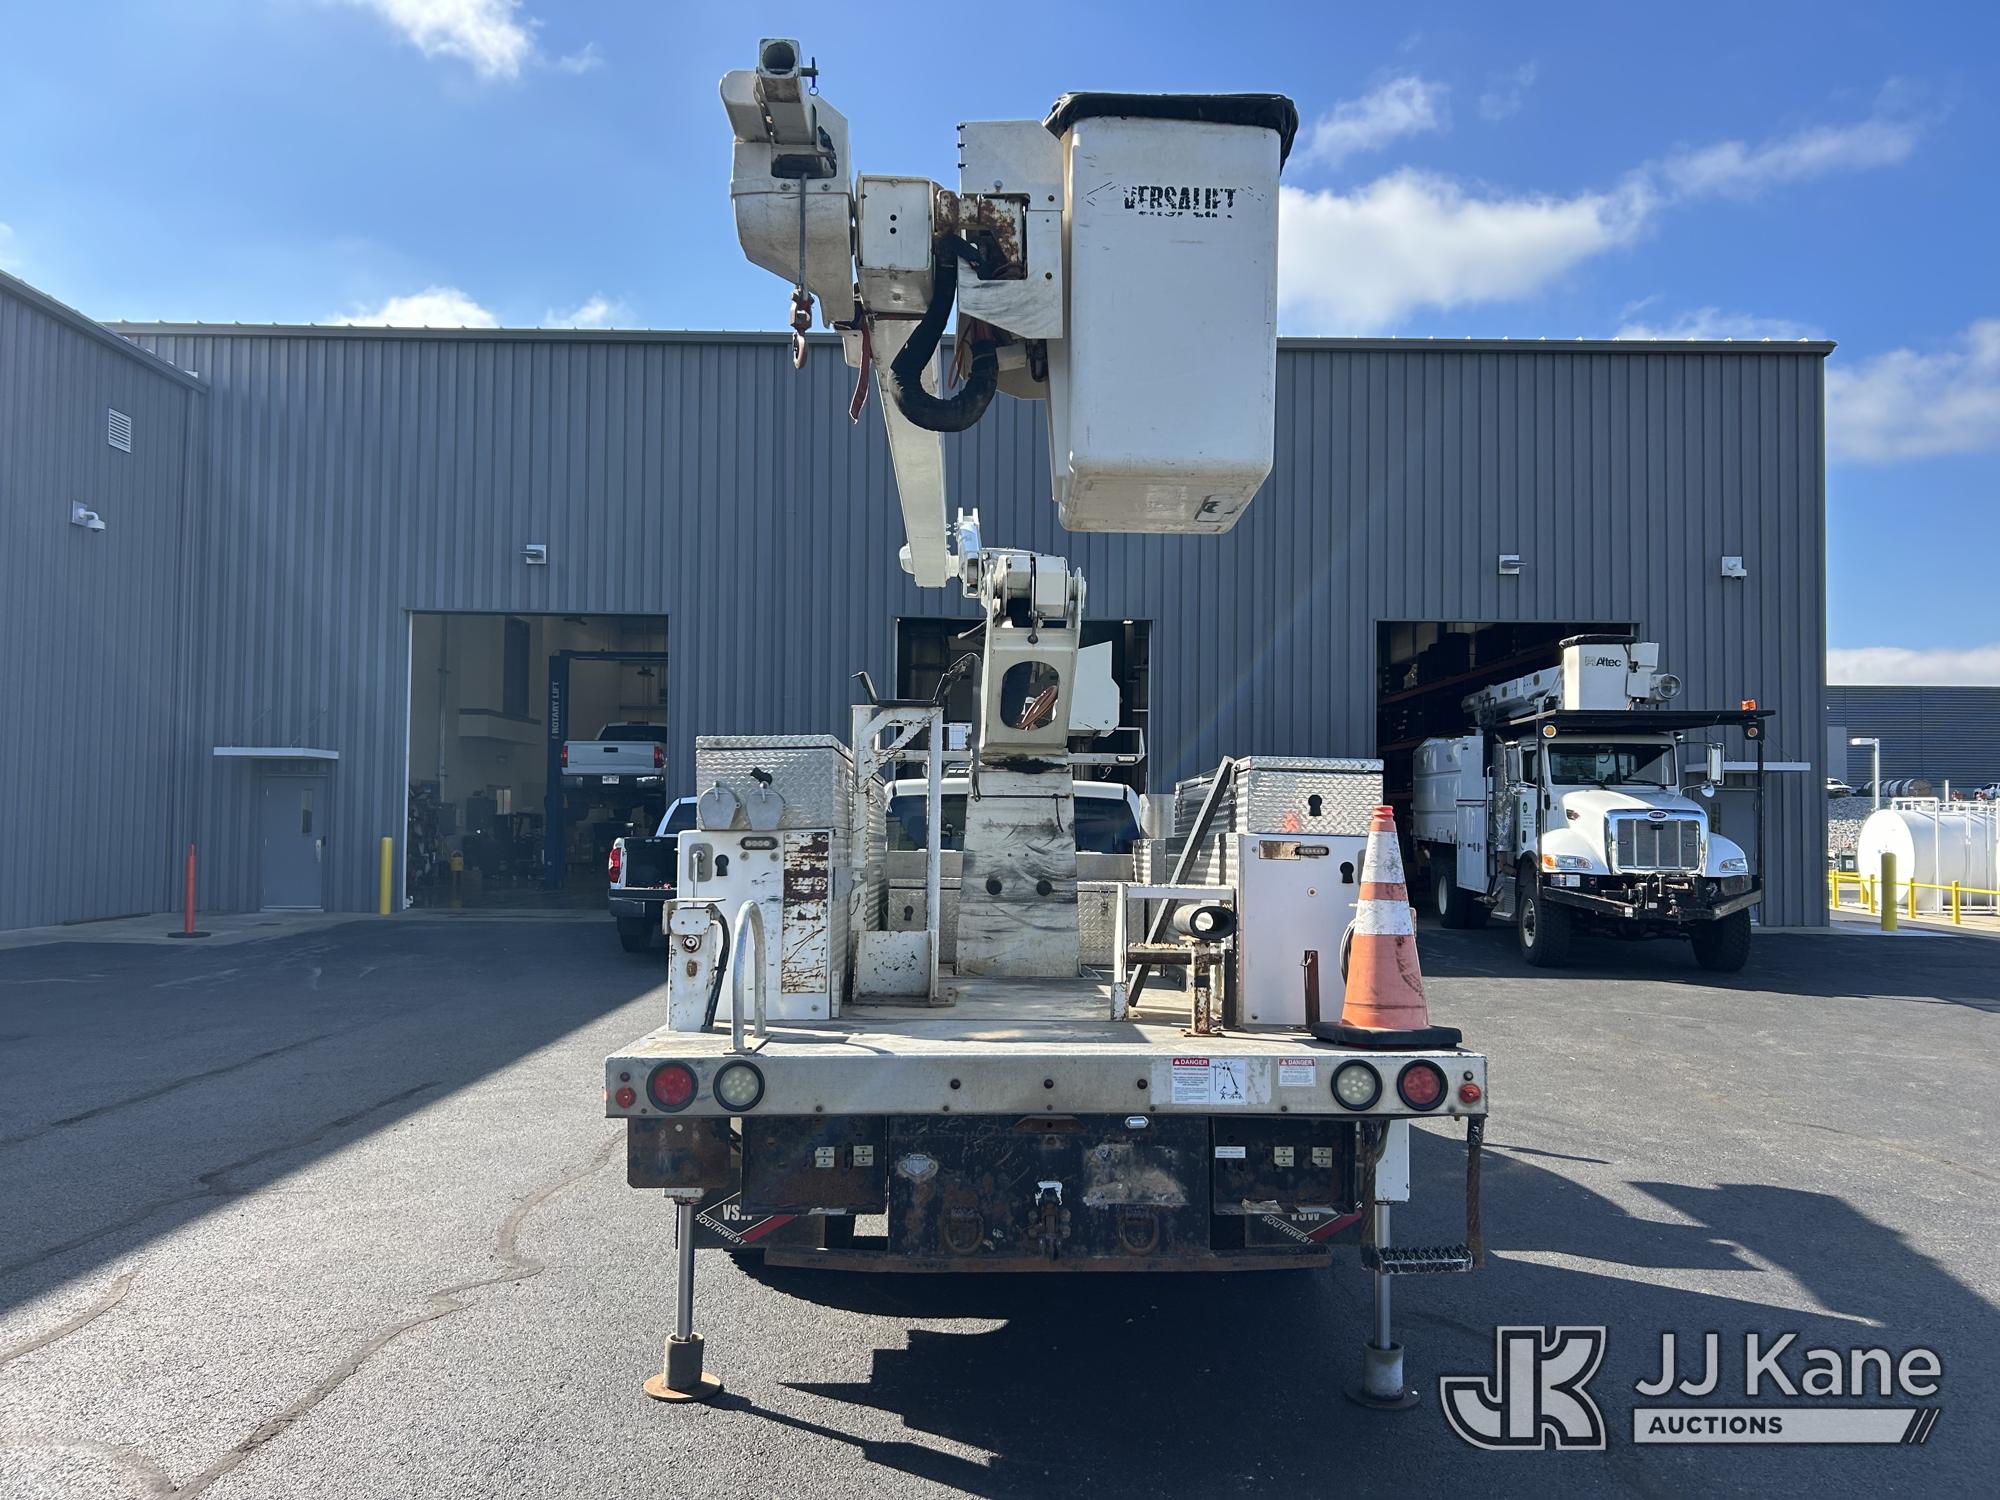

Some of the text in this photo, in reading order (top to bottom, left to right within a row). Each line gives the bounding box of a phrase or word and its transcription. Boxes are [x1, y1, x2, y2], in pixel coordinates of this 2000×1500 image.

[1595, 656, 1622, 668] Altec
[722, 1204, 753, 1221] VS
[694, 1213, 748, 1246] SOUTHWEST
[1261, 1214, 1315, 1245] SOUTHWEST
